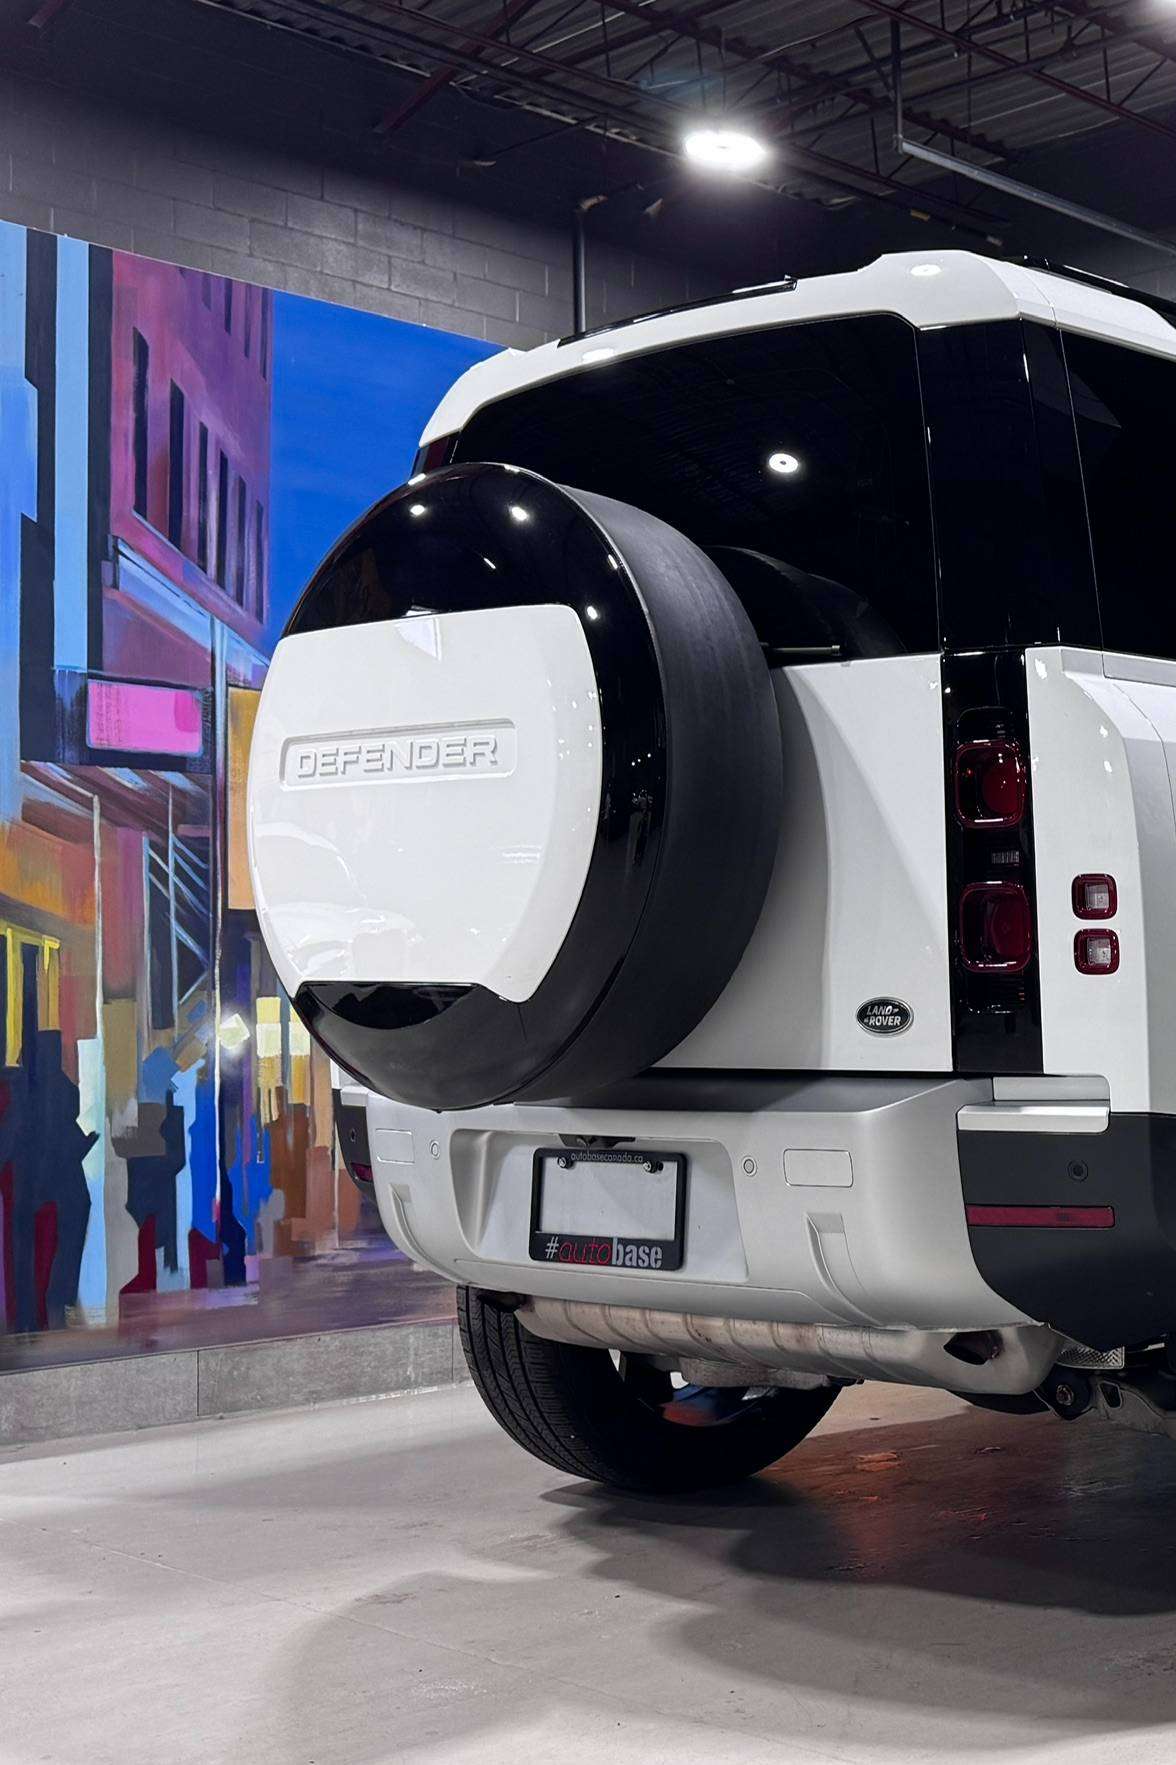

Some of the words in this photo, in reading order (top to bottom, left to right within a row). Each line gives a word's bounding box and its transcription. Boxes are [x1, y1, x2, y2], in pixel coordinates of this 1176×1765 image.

[297, 735, 498, 779] DEFENDER
[867, 1005, 893, 1015] LAND
[869, 1016, 902, 1026] ROVER
[570, 1151, 644, 1163] autobasecanada.ca
